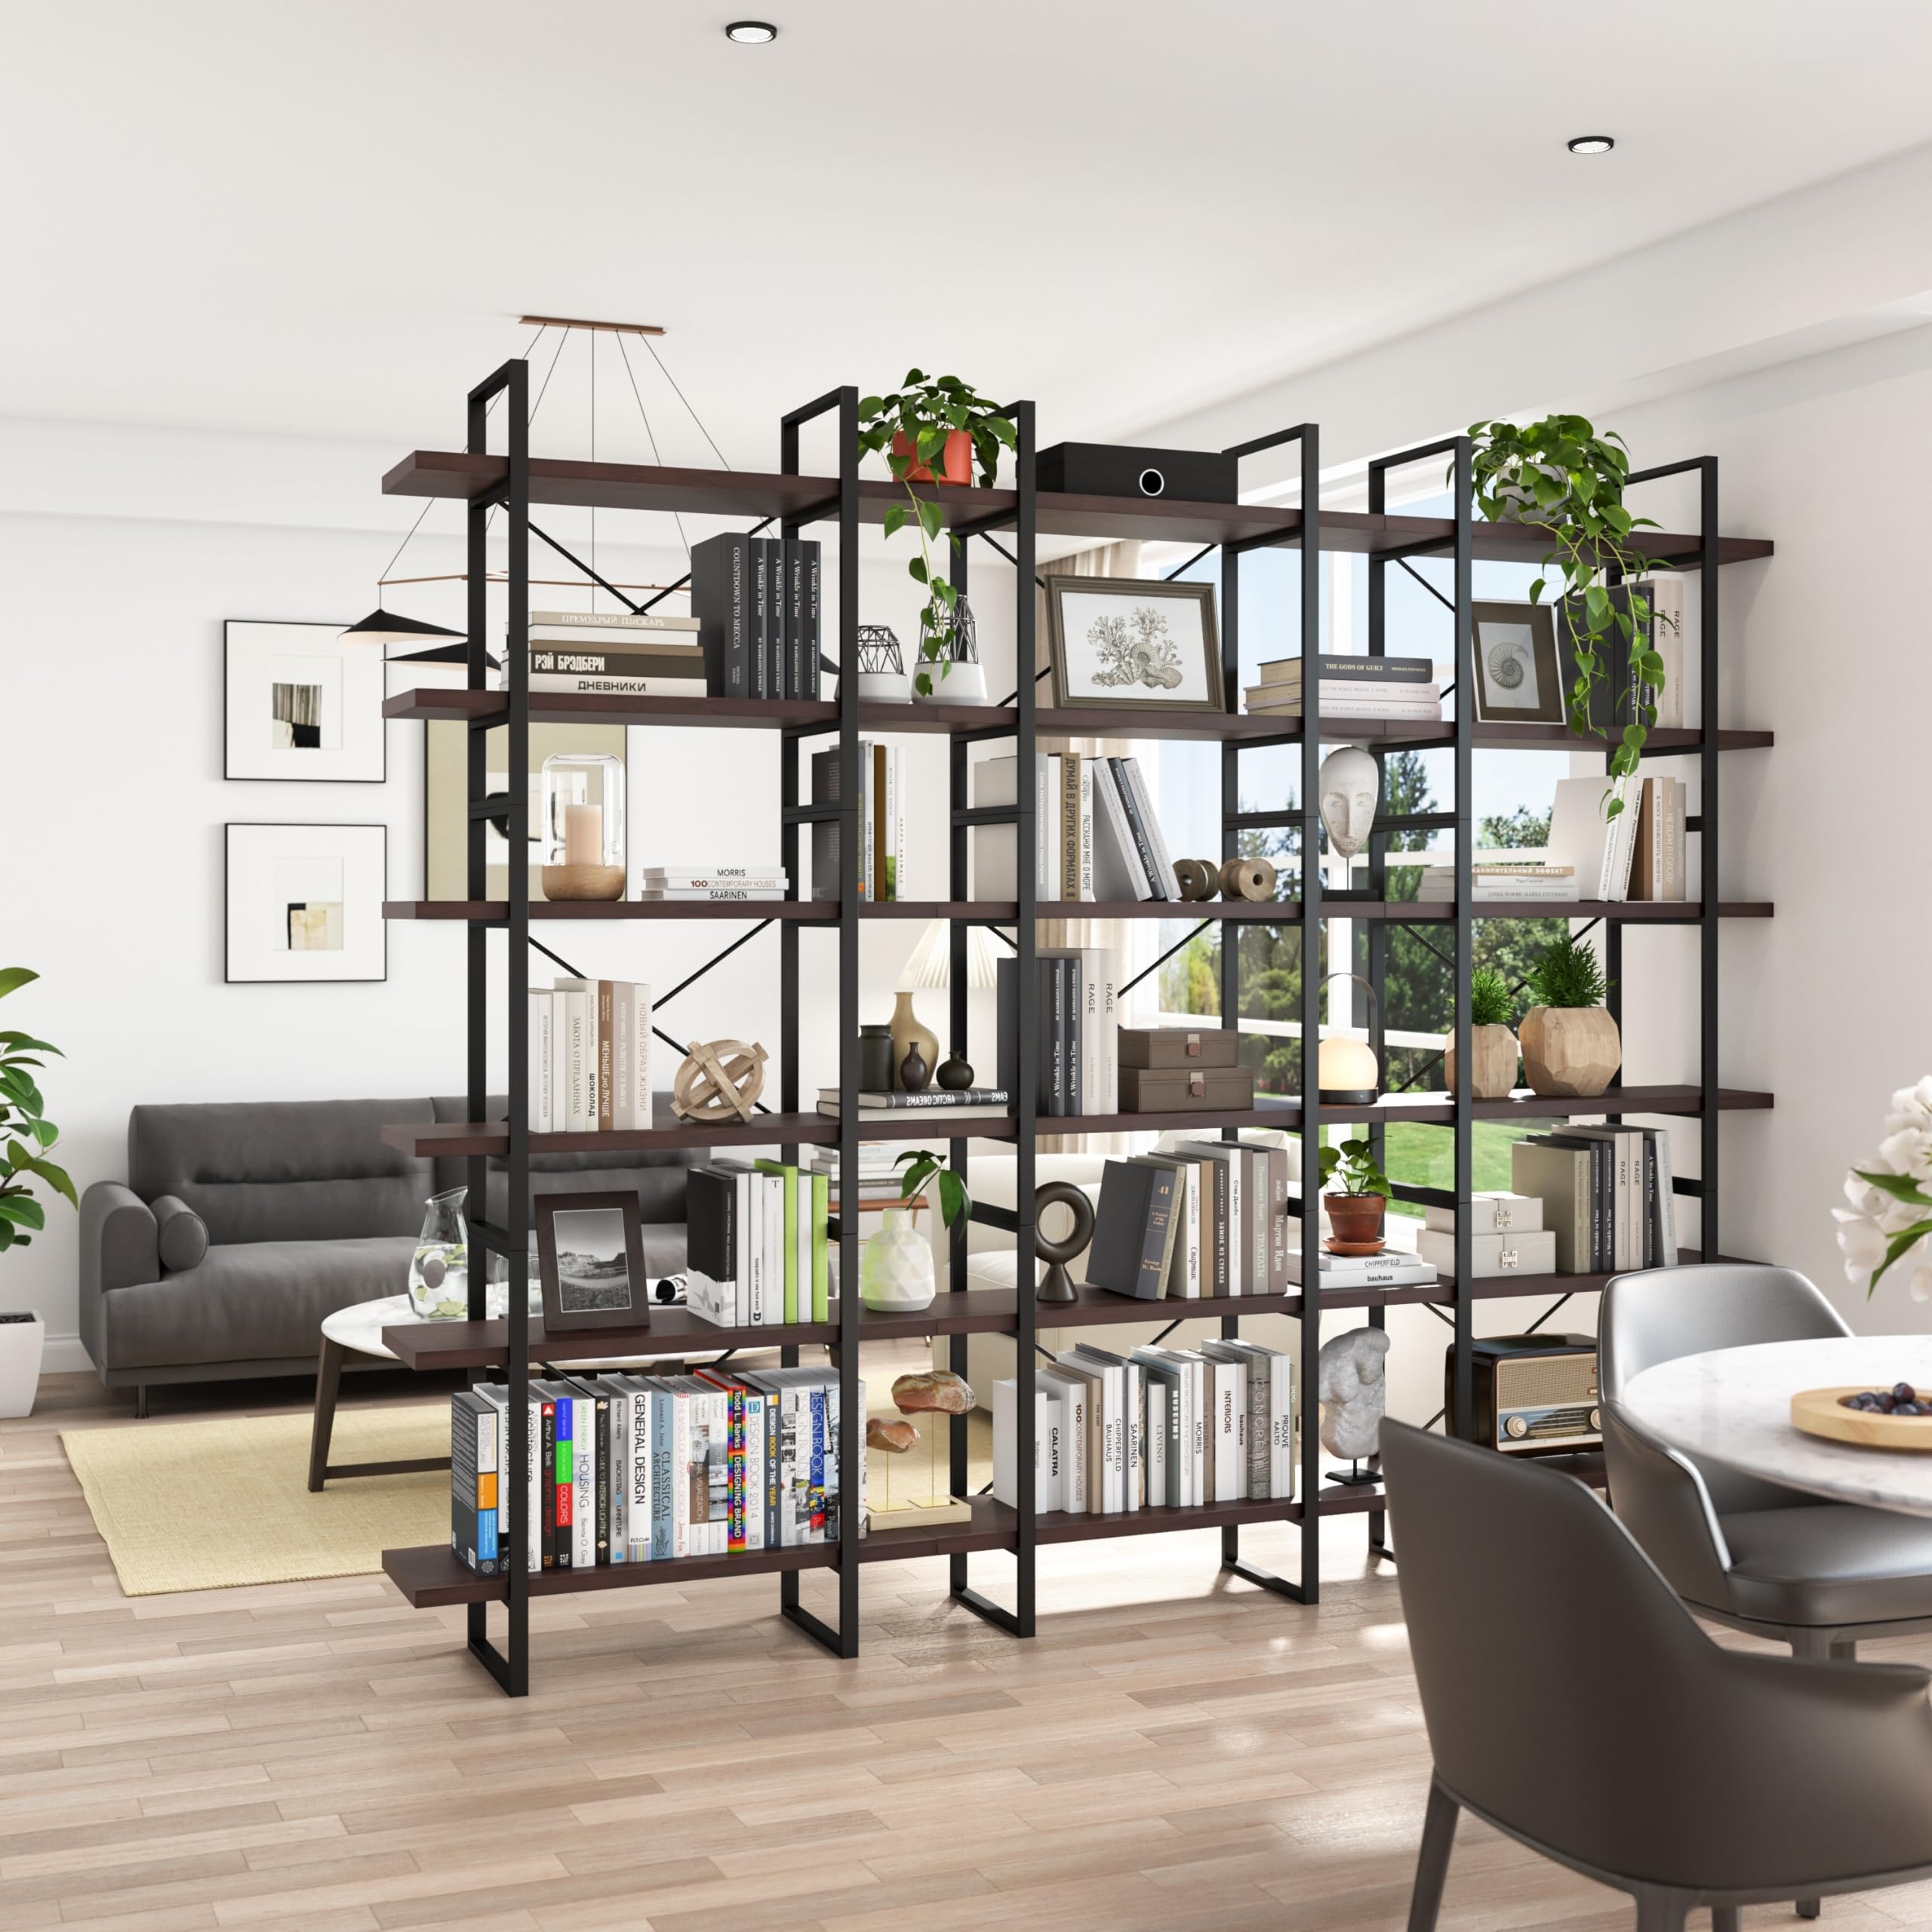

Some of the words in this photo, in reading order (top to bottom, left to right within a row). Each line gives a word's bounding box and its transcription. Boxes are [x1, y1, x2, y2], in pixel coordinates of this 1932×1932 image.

[561, 614, 617, 625] ПРЕМУДРЫЙ
[734, 605, 740, 617] TO
[534, 653, 554, 670] РЭЙ
[558, 655, 605, 672] БРЭДБЕРИ
[577, 681, 646, 691] ДНЕВНИКИ
[1065, 758, 1078, 789] ДУМАЙ
[1065, 801, 1075, 837] ДРУГИХ
[1666, 814, 1673, 825] НЕ
[1066, 841, 1075, 888] ФОРМАТАХ
[710, 891, 747, 900] SAARINEN
[601, 1088, 610, 1117] ЛУЧШЕ
[771, 1180, 779, 1188] T
[1274, 1215, 1284, 1246] Мартин
[1189, 1247, 1198, 1281] Спартак
[1219, 1247, 1224, 1256] из
[1274, 1250, 1284, 1272] Иден
[1364, 1259, 1400, 1268] CHIPPERFIELD
[753, 1313, 761, 1321] D
[635, 1394, 645, 1454] GENERAL
[797, 1390, 808, 1434] DESIGN
[811, 1390, 823, 1433] DESIGN
[678, 1441, 685, 1453] OF
[749, 1416, 759, 1454] DESIGN
[769, 1460, 776, 1469] OF
[797, 1440, 808, 1478] BOOK
[811, 1437, 823, 1475] BOOK
[579, 1454, 589, 1508] HOUSING
[635, 1456, 645, 1504] DESIGN
[653, 1452, 661, 1521] ARCHITECTURE
[661, 1451, 670, 1521] CLASSICAL
[749, 1457, 759, 1488] BOOK
[560, 1485, 568, 1524] COLORS
[749, 1493, 759, 1518] 2014
